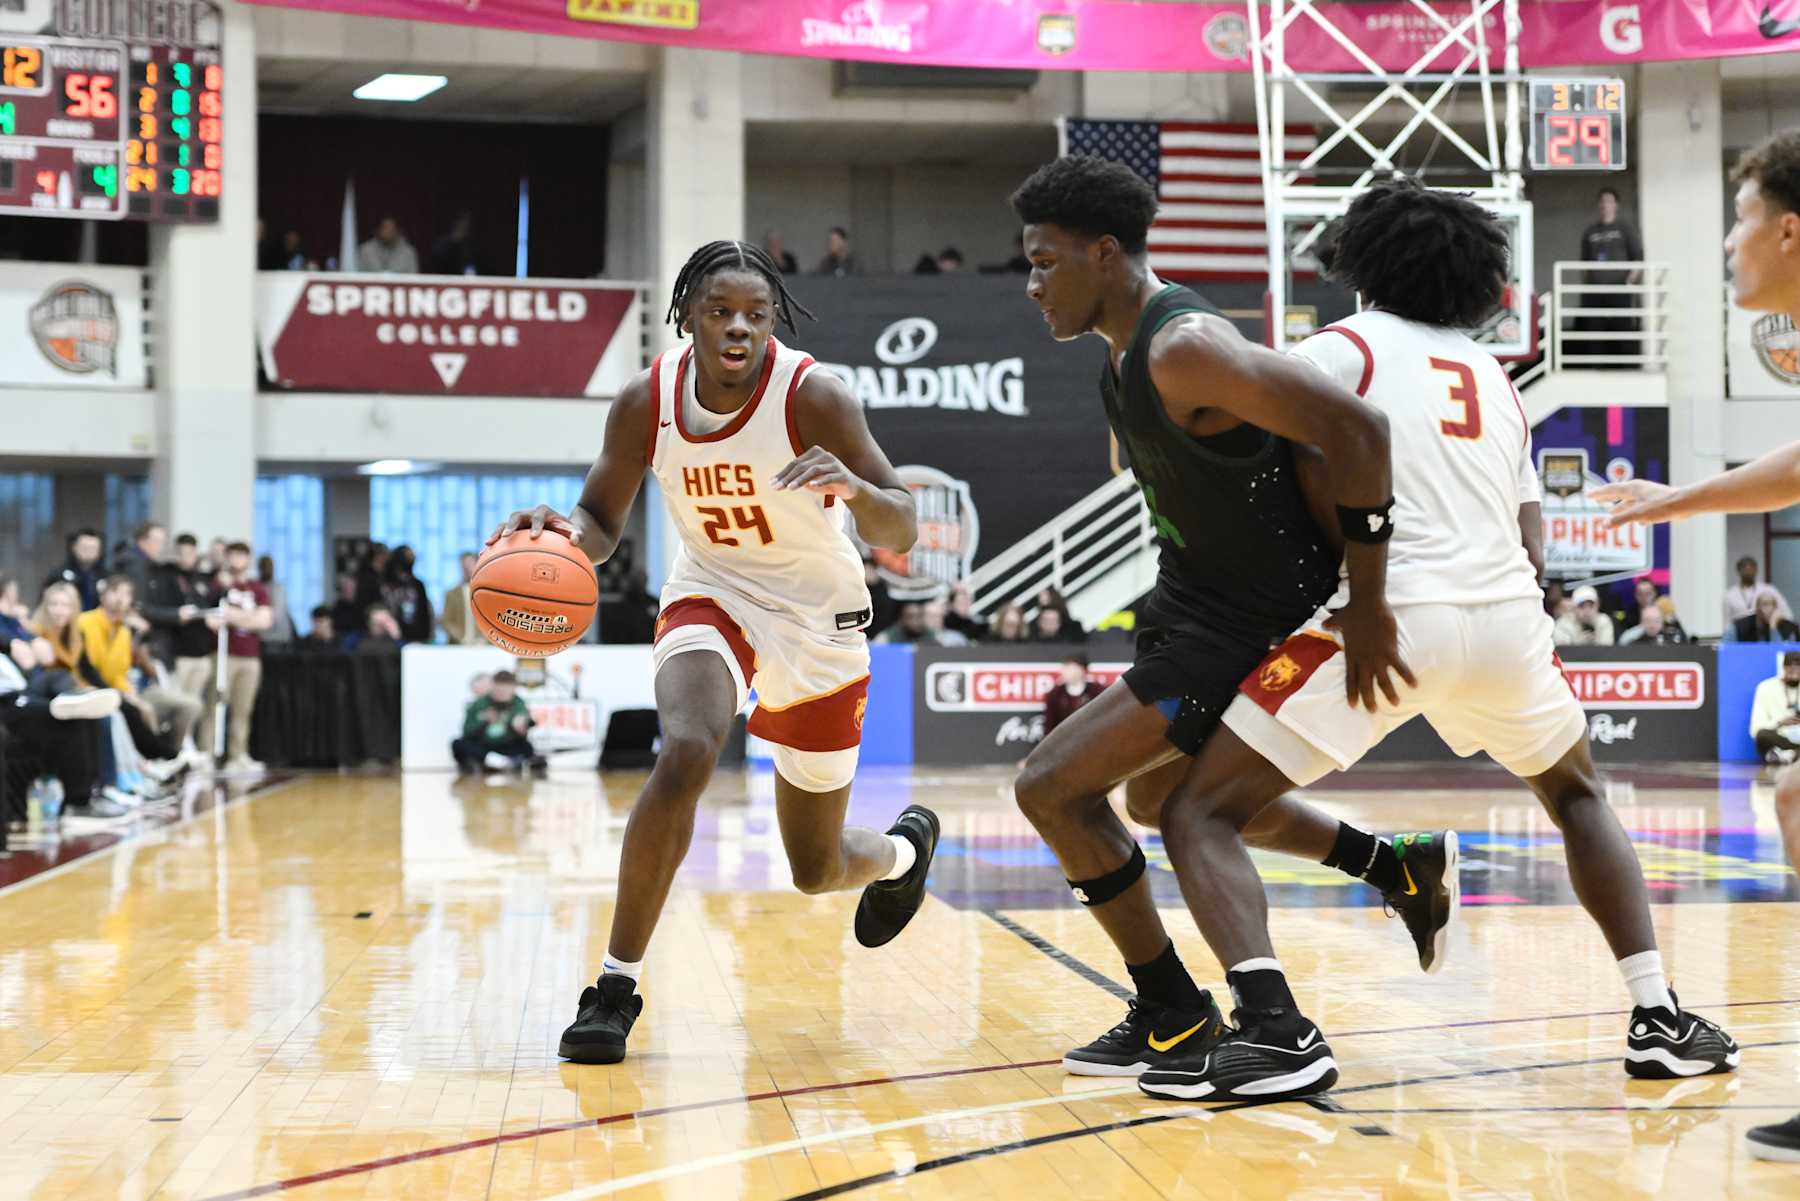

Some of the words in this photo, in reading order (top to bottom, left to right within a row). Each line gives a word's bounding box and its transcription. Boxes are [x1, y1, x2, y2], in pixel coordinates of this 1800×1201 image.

[65, 73, 117, 119] 56
[1550, 116, 1610, 166] 29
[92, 163, 117, 198] 4
[306, 284, 588, 321] SPRINGFIELD
[376, 323, 519, 347] COLLEGE
[1428, 355, 1483, 443] 3
[682, 463, 757, 497] HIES
[696, 504, 775, 547] 24
[1541, 512, 1641, 550] PHALL
[496, 611, 575, 635] PRECISION
